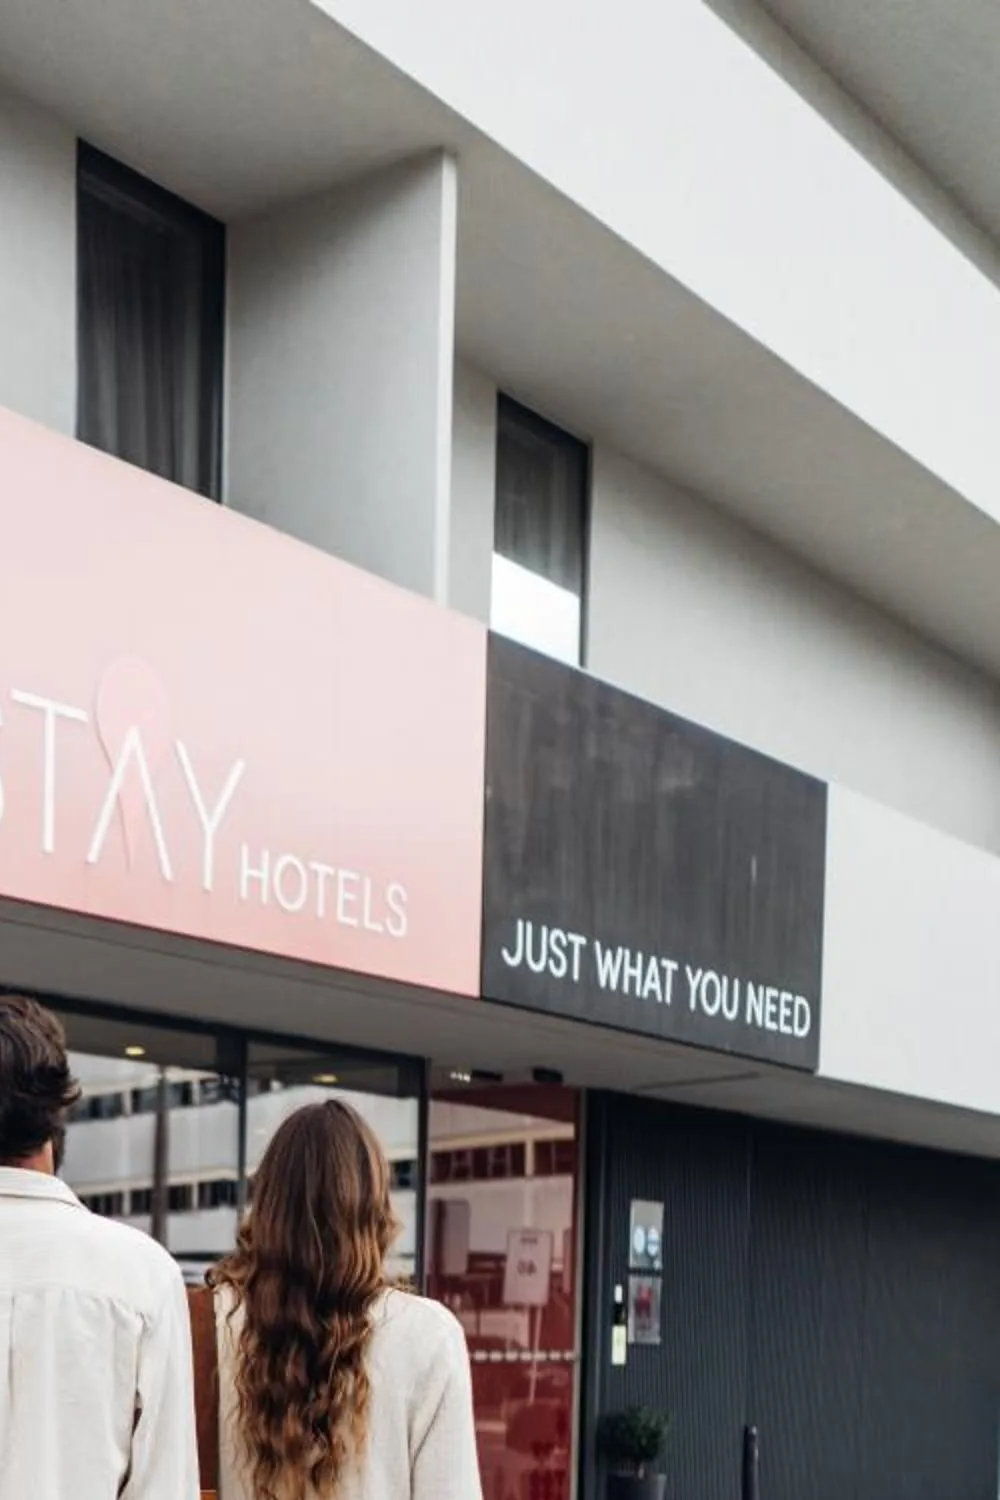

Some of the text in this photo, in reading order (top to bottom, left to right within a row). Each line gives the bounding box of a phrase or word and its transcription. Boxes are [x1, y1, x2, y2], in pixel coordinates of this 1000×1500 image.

[239, 843, 408, 938] HOTELS
[501, 918, 812, 1038] JUST WHAT YOU NEED
